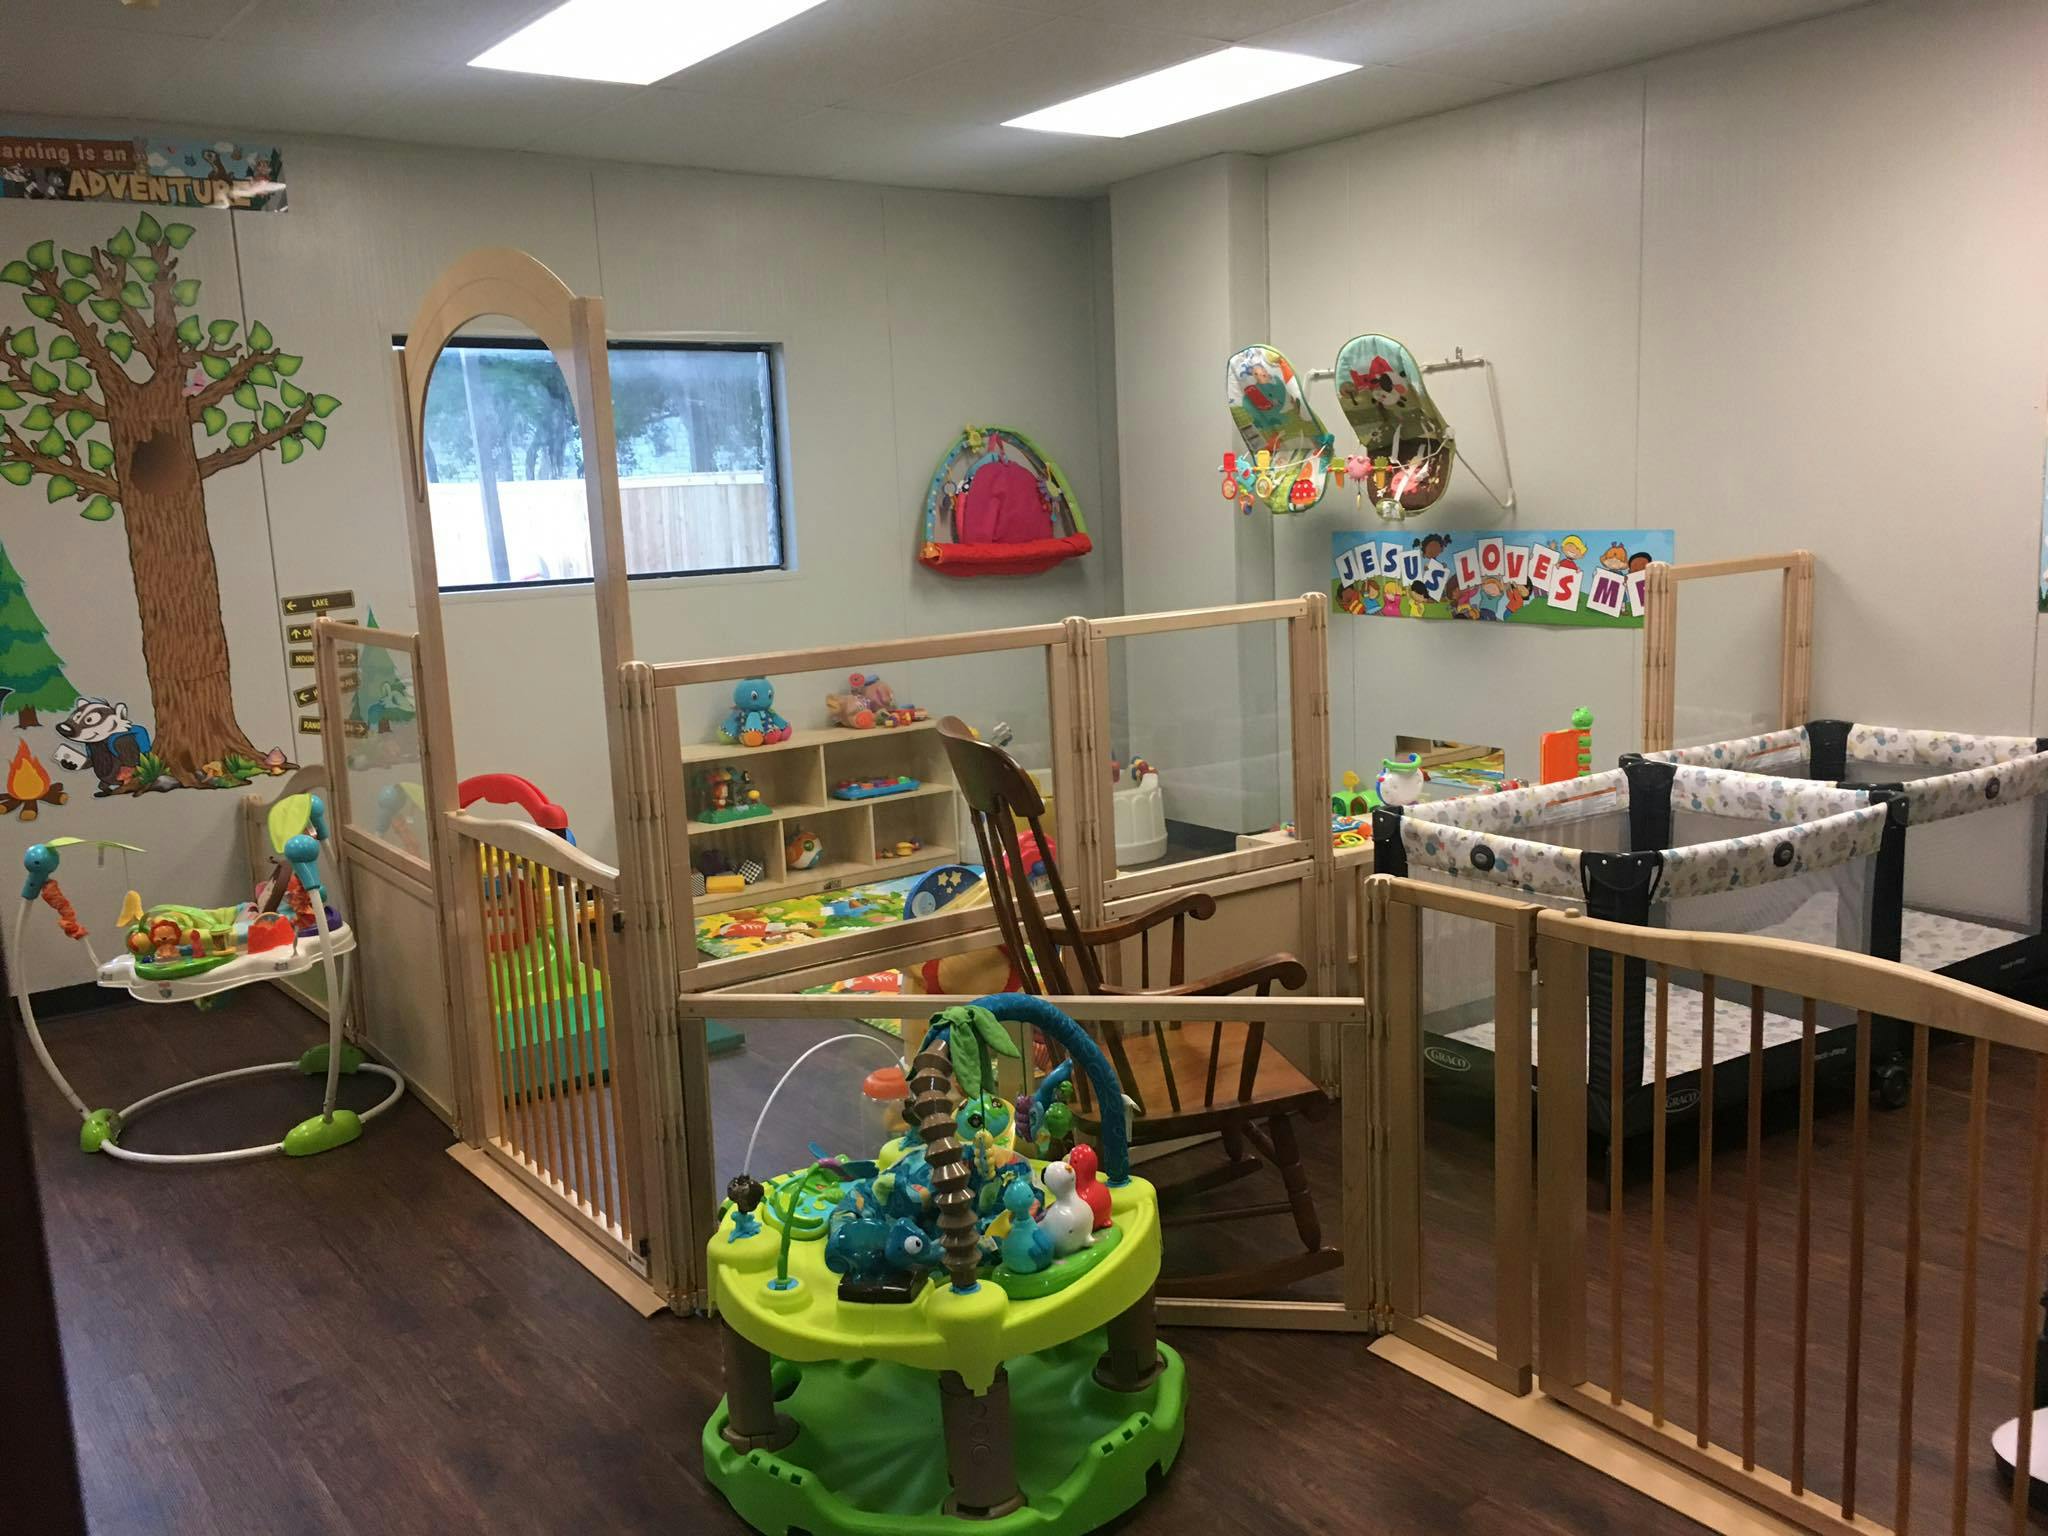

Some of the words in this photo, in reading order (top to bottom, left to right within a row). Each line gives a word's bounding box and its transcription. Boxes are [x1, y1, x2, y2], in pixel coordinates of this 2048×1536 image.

[2, 142, 70, 165] arning
[103, 145, 127, 162] an
[67, 168, 251, 208] ADVENTURE
[1343, 549, 1445, 592] JESUS
[1459, 542, 1575, 605] LOVES
[312, 598, 329, 608] LAKE
[1430, 1049, 1467, 1068] GRACO
